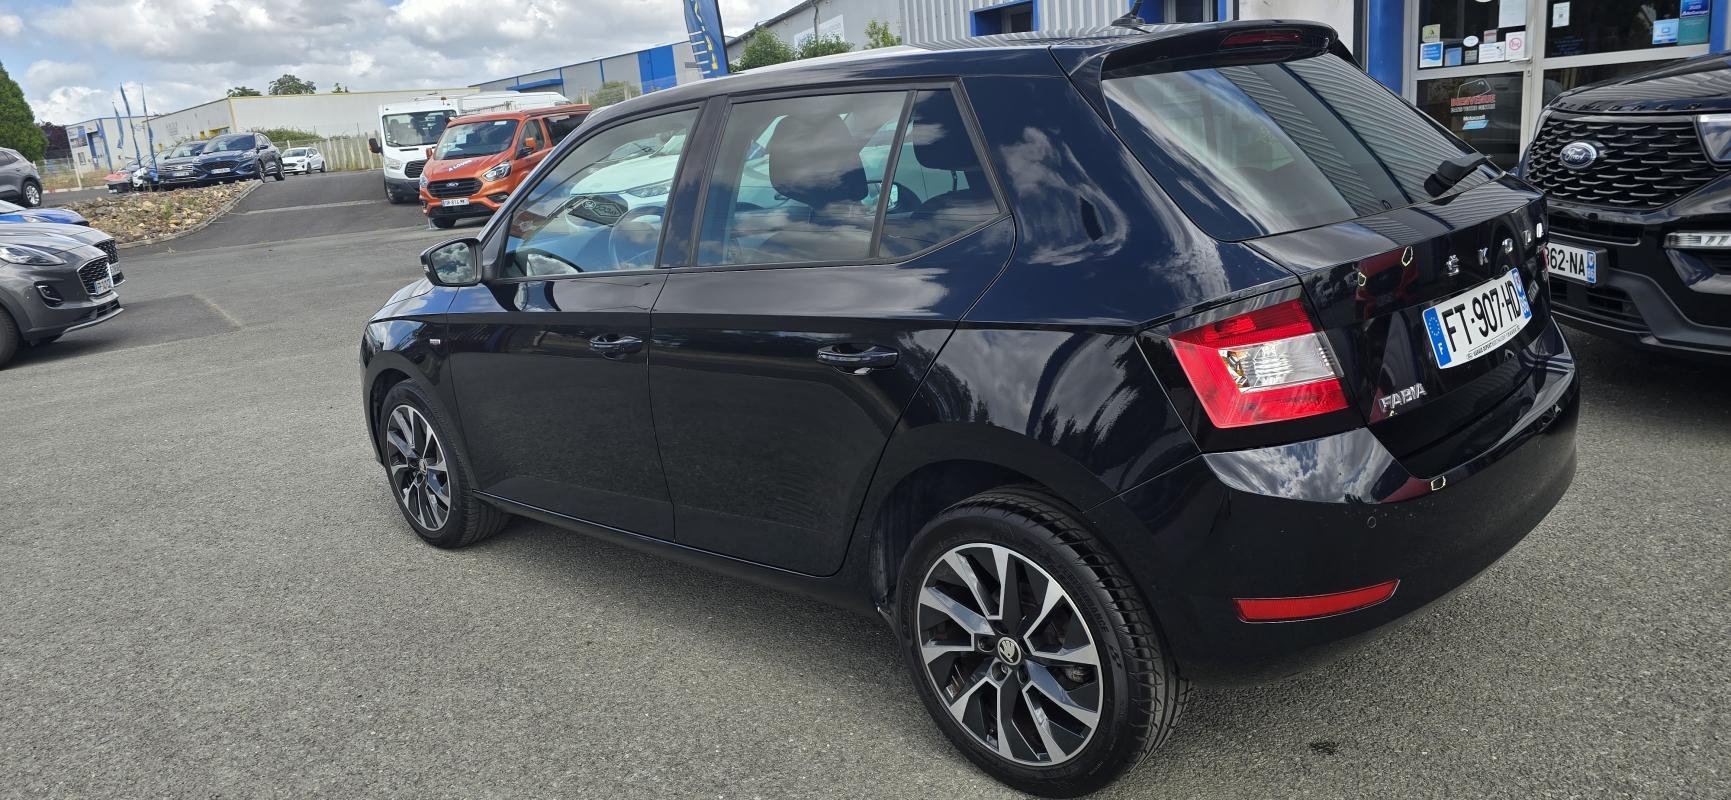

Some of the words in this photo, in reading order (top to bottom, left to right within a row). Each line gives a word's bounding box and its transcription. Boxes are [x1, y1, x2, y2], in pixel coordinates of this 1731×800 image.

[1441, 280, 1522, 353] FT-907-HD
[1437, 341, 1444, 356] F
[1379, 382, 1428, 413] FABIA
